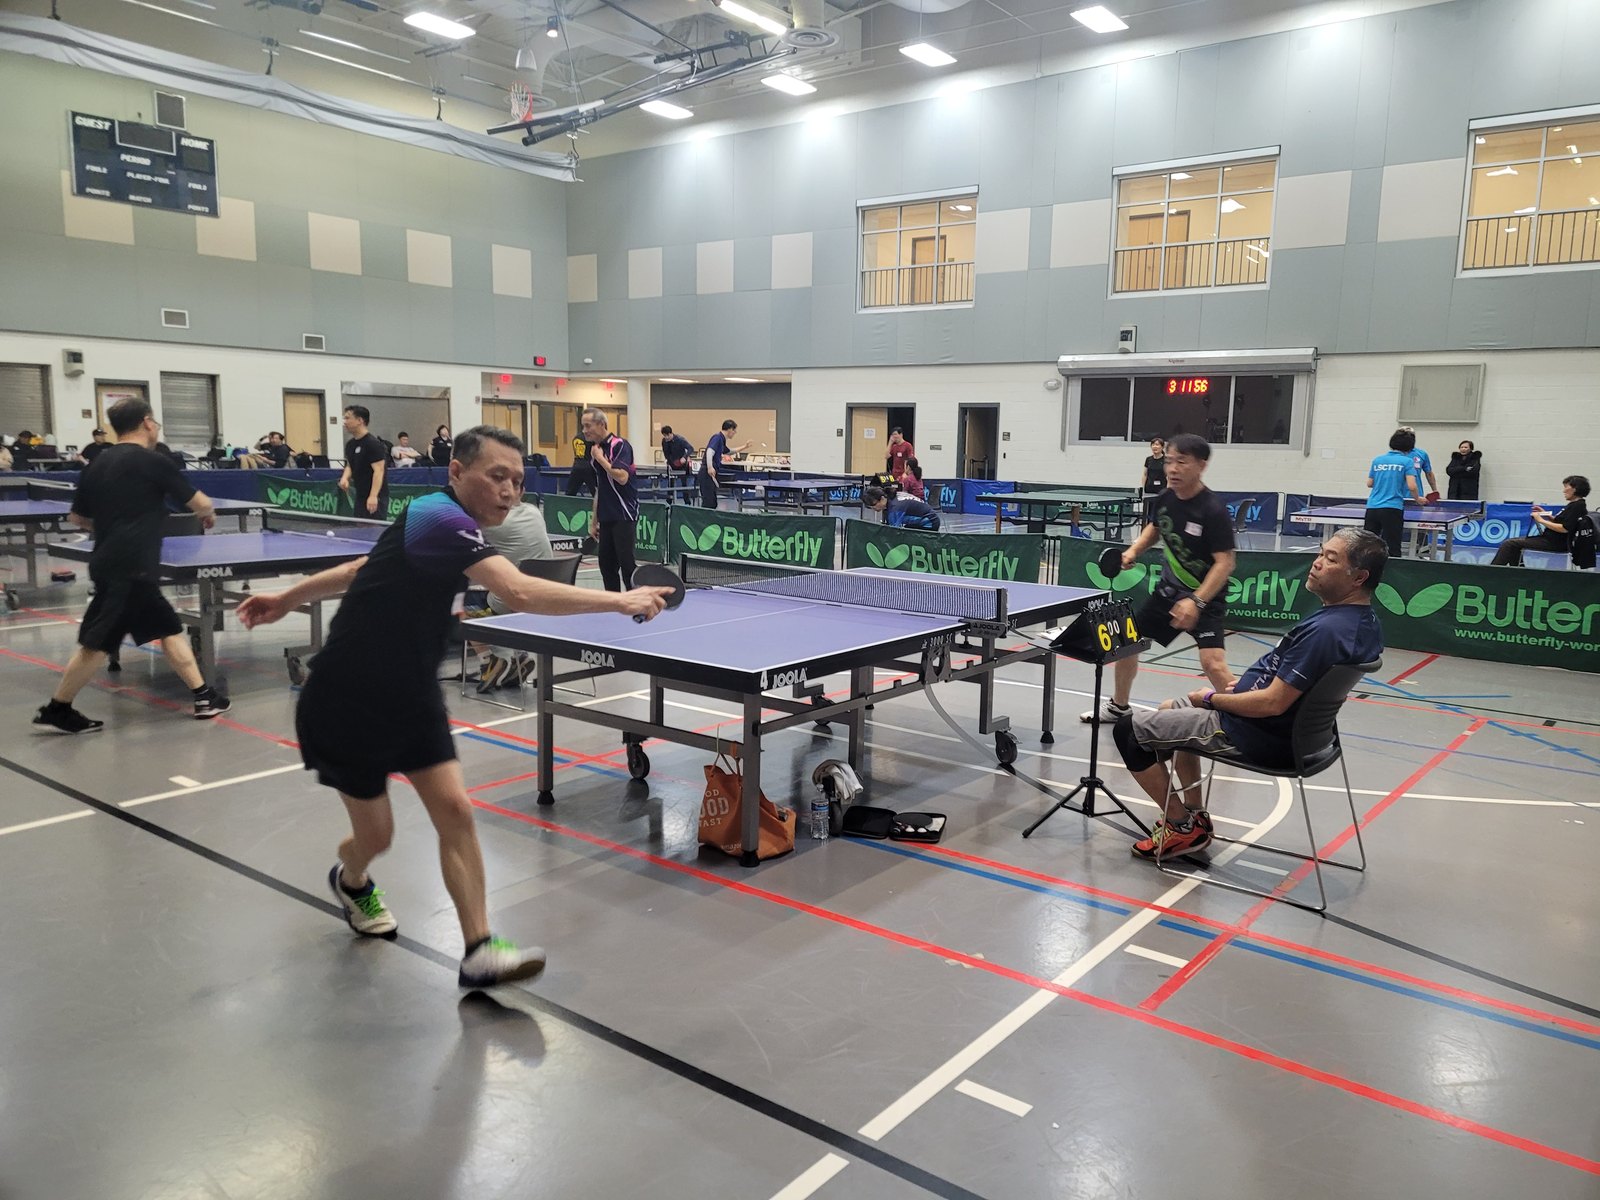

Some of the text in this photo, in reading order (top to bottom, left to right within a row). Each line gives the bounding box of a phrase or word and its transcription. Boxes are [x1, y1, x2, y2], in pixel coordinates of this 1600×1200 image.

[75, 116, 112, 131] GUEST
[181, 137, 210, 151] HOME
[120, 153, 152, 166] PERIOD
[290, 489, 338, 514] Butterfly
[553, 542, 574, 551] JOOLA
[722, 526, 823, 567] Butterfly
[197, 566, 233, 579] JOOLA
[911, 545, 1020, 581] Butterfly
[1455, 585, 1600, 636] Butter
[1097, 623, 1112, 652] 6
[1126, 617, 1138, 643] 4
[580, 649, 616, 669] JOOLA
[760, 667, 808, 690] 4 JOOLA
